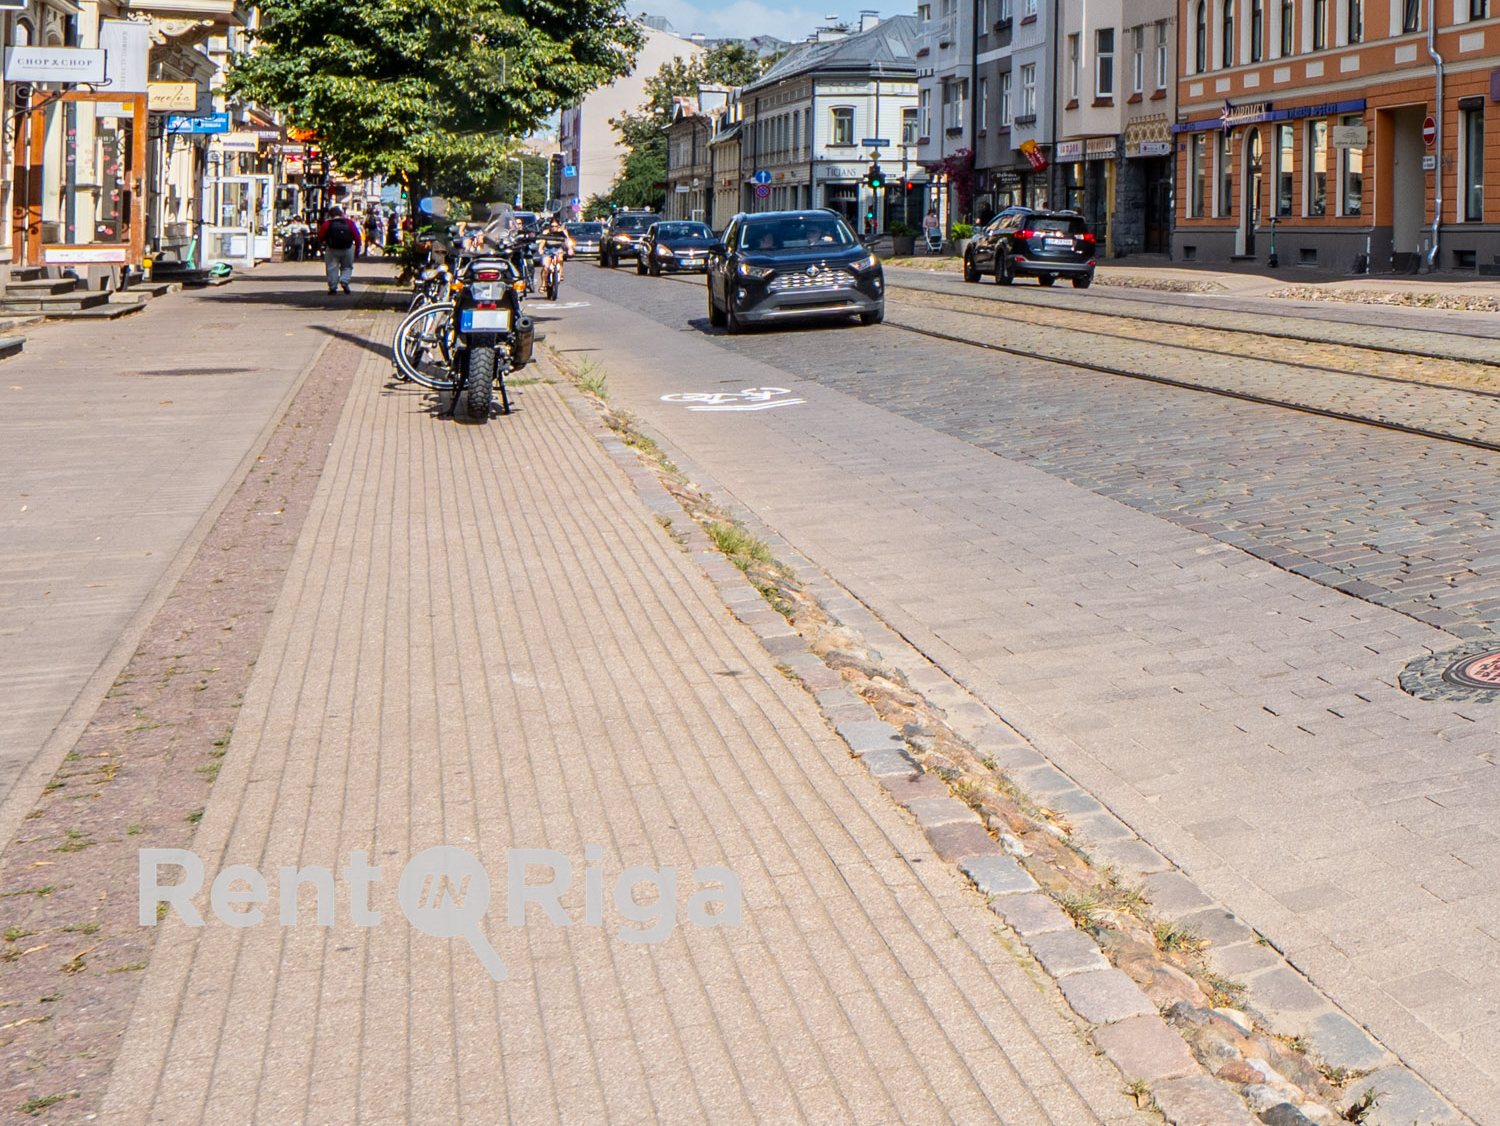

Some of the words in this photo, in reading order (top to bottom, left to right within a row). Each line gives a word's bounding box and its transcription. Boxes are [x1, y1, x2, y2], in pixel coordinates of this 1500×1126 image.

[17, 58, 50, 66] CHOP
[60, 58, 93, 66] CHOP
[826, 167, 857, 178] TICIANS
